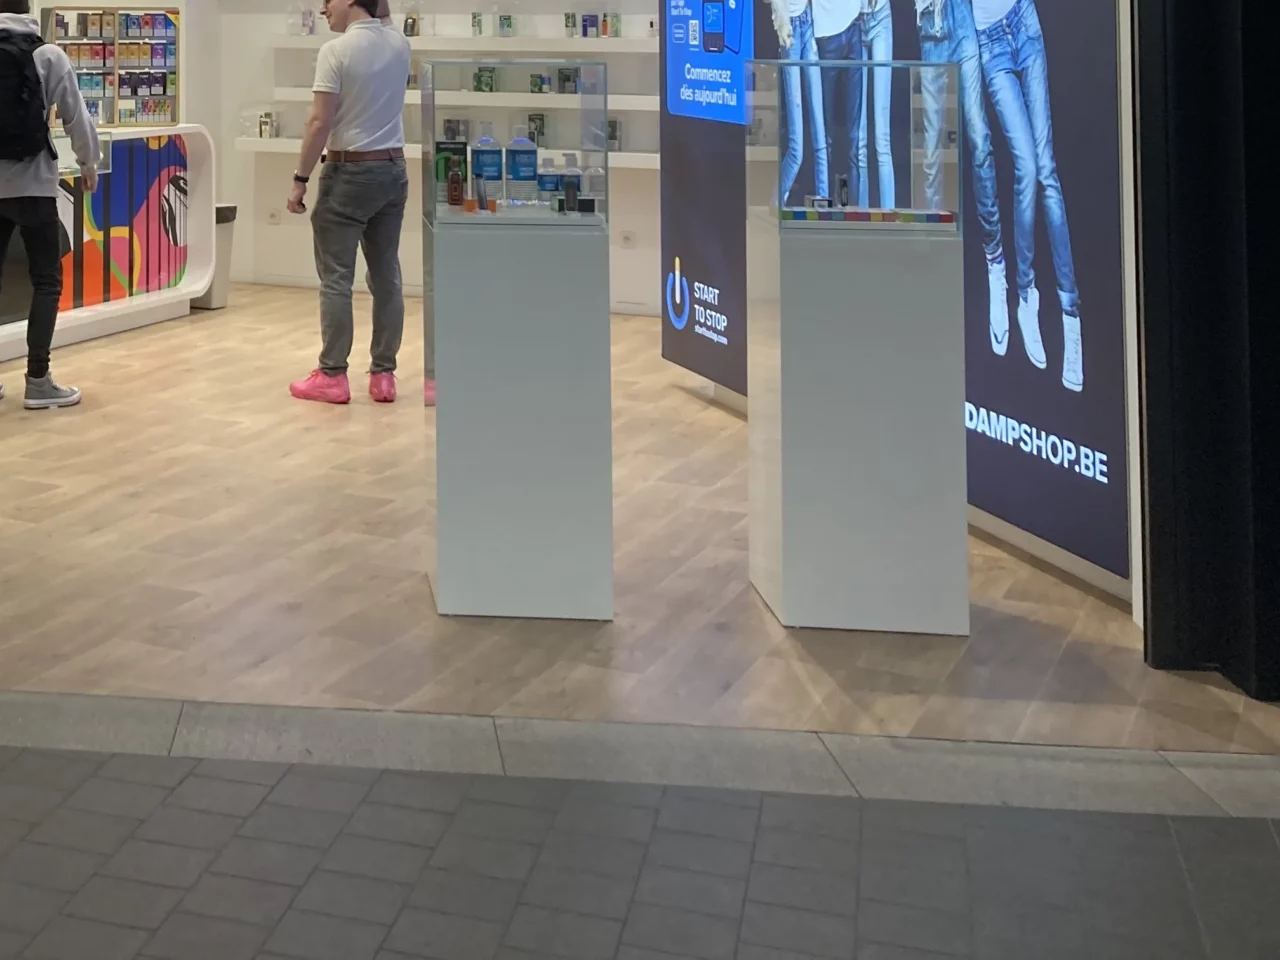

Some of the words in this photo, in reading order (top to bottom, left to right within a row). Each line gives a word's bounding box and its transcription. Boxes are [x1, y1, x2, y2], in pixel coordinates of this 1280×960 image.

[684, 63, 731, 83] Commencez
[680, 83, 693, 101] dès
[694, 85, 737, 107] aujourd'hui
[693, 281, 720, 306] START
[693, 304, 705, 323] TO
[705, 309, 728, 332] STOP
[964, 401, 1109, 484] DAMPSHOP.BE
